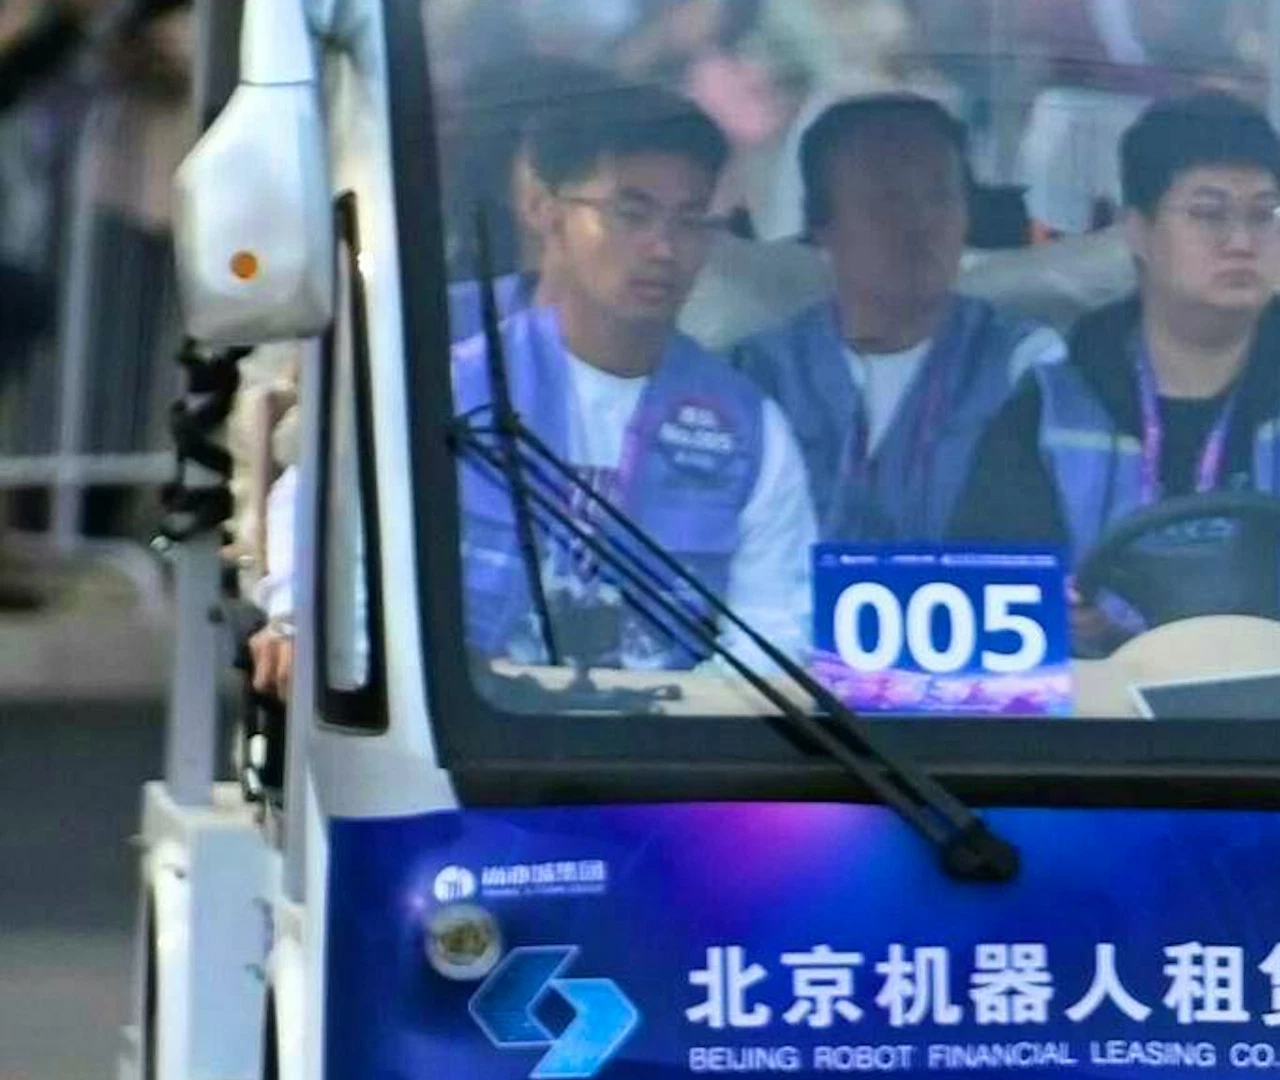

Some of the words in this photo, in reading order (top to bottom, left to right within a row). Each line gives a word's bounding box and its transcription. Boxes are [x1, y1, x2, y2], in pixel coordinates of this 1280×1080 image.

[833, 581, 1048, 672] 005
[689, 1046, 800, 1072] BEIJING
[813, 1045, 913, 1070] ROBOT
[928, 1043, 1078, 1070] FINANCIAL
[1090, 1040, 1216, 1067] LEASING
